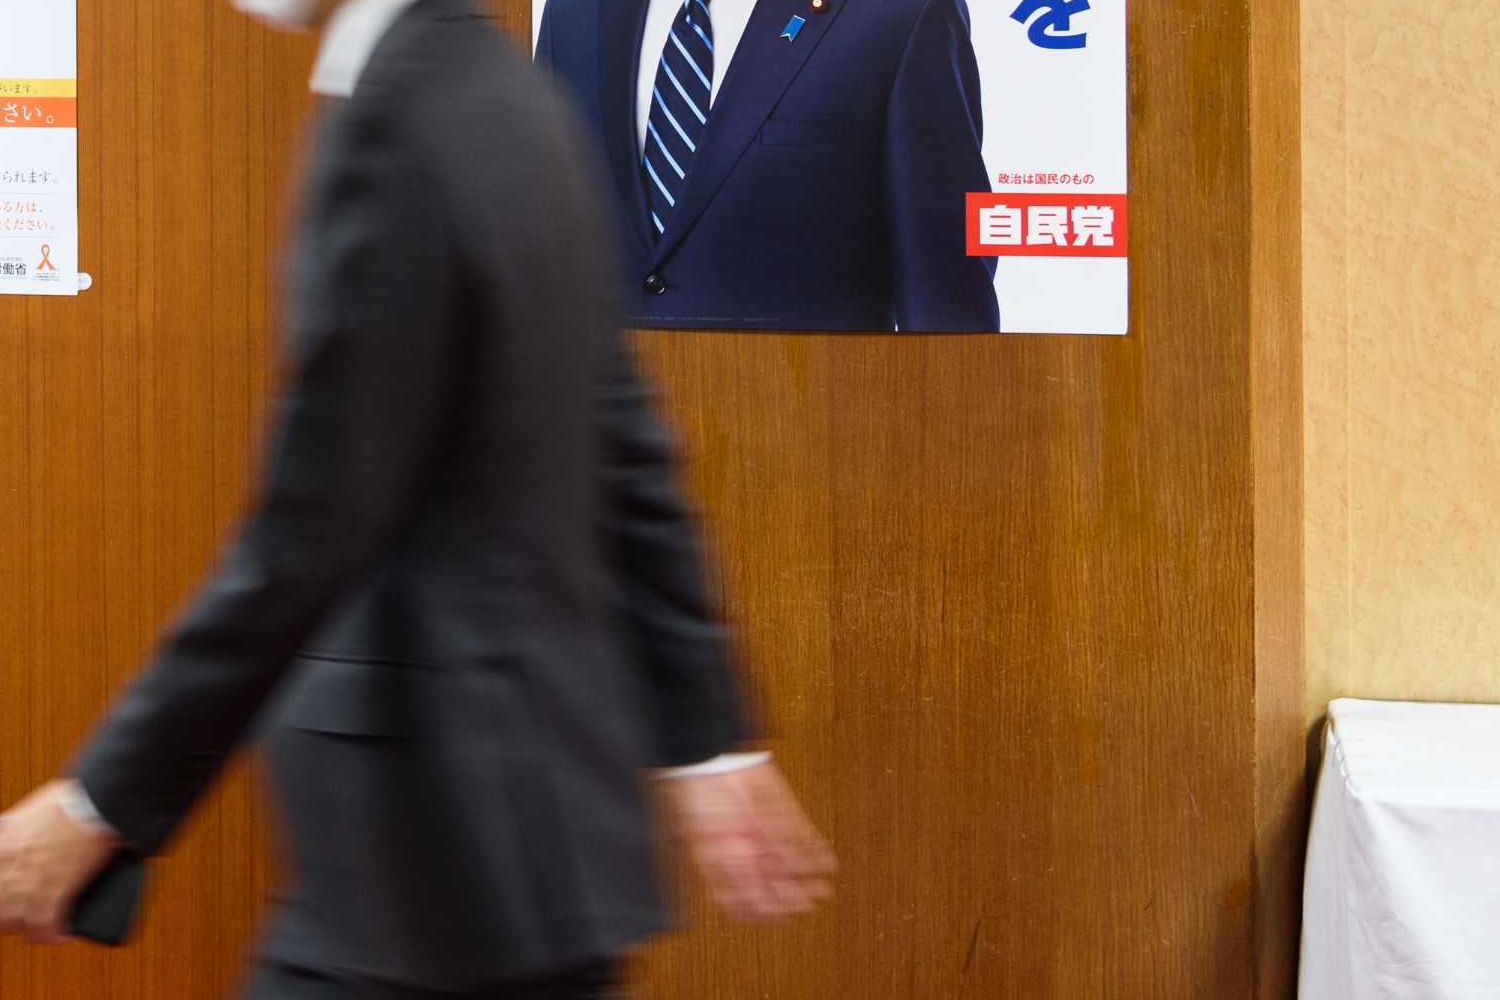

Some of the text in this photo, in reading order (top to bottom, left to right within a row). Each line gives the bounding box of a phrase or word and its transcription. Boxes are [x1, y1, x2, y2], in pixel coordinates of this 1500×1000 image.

[998, 173, 1095, 185] 政治は国民のもの
[979, 204, 1115, 247] 自民党
